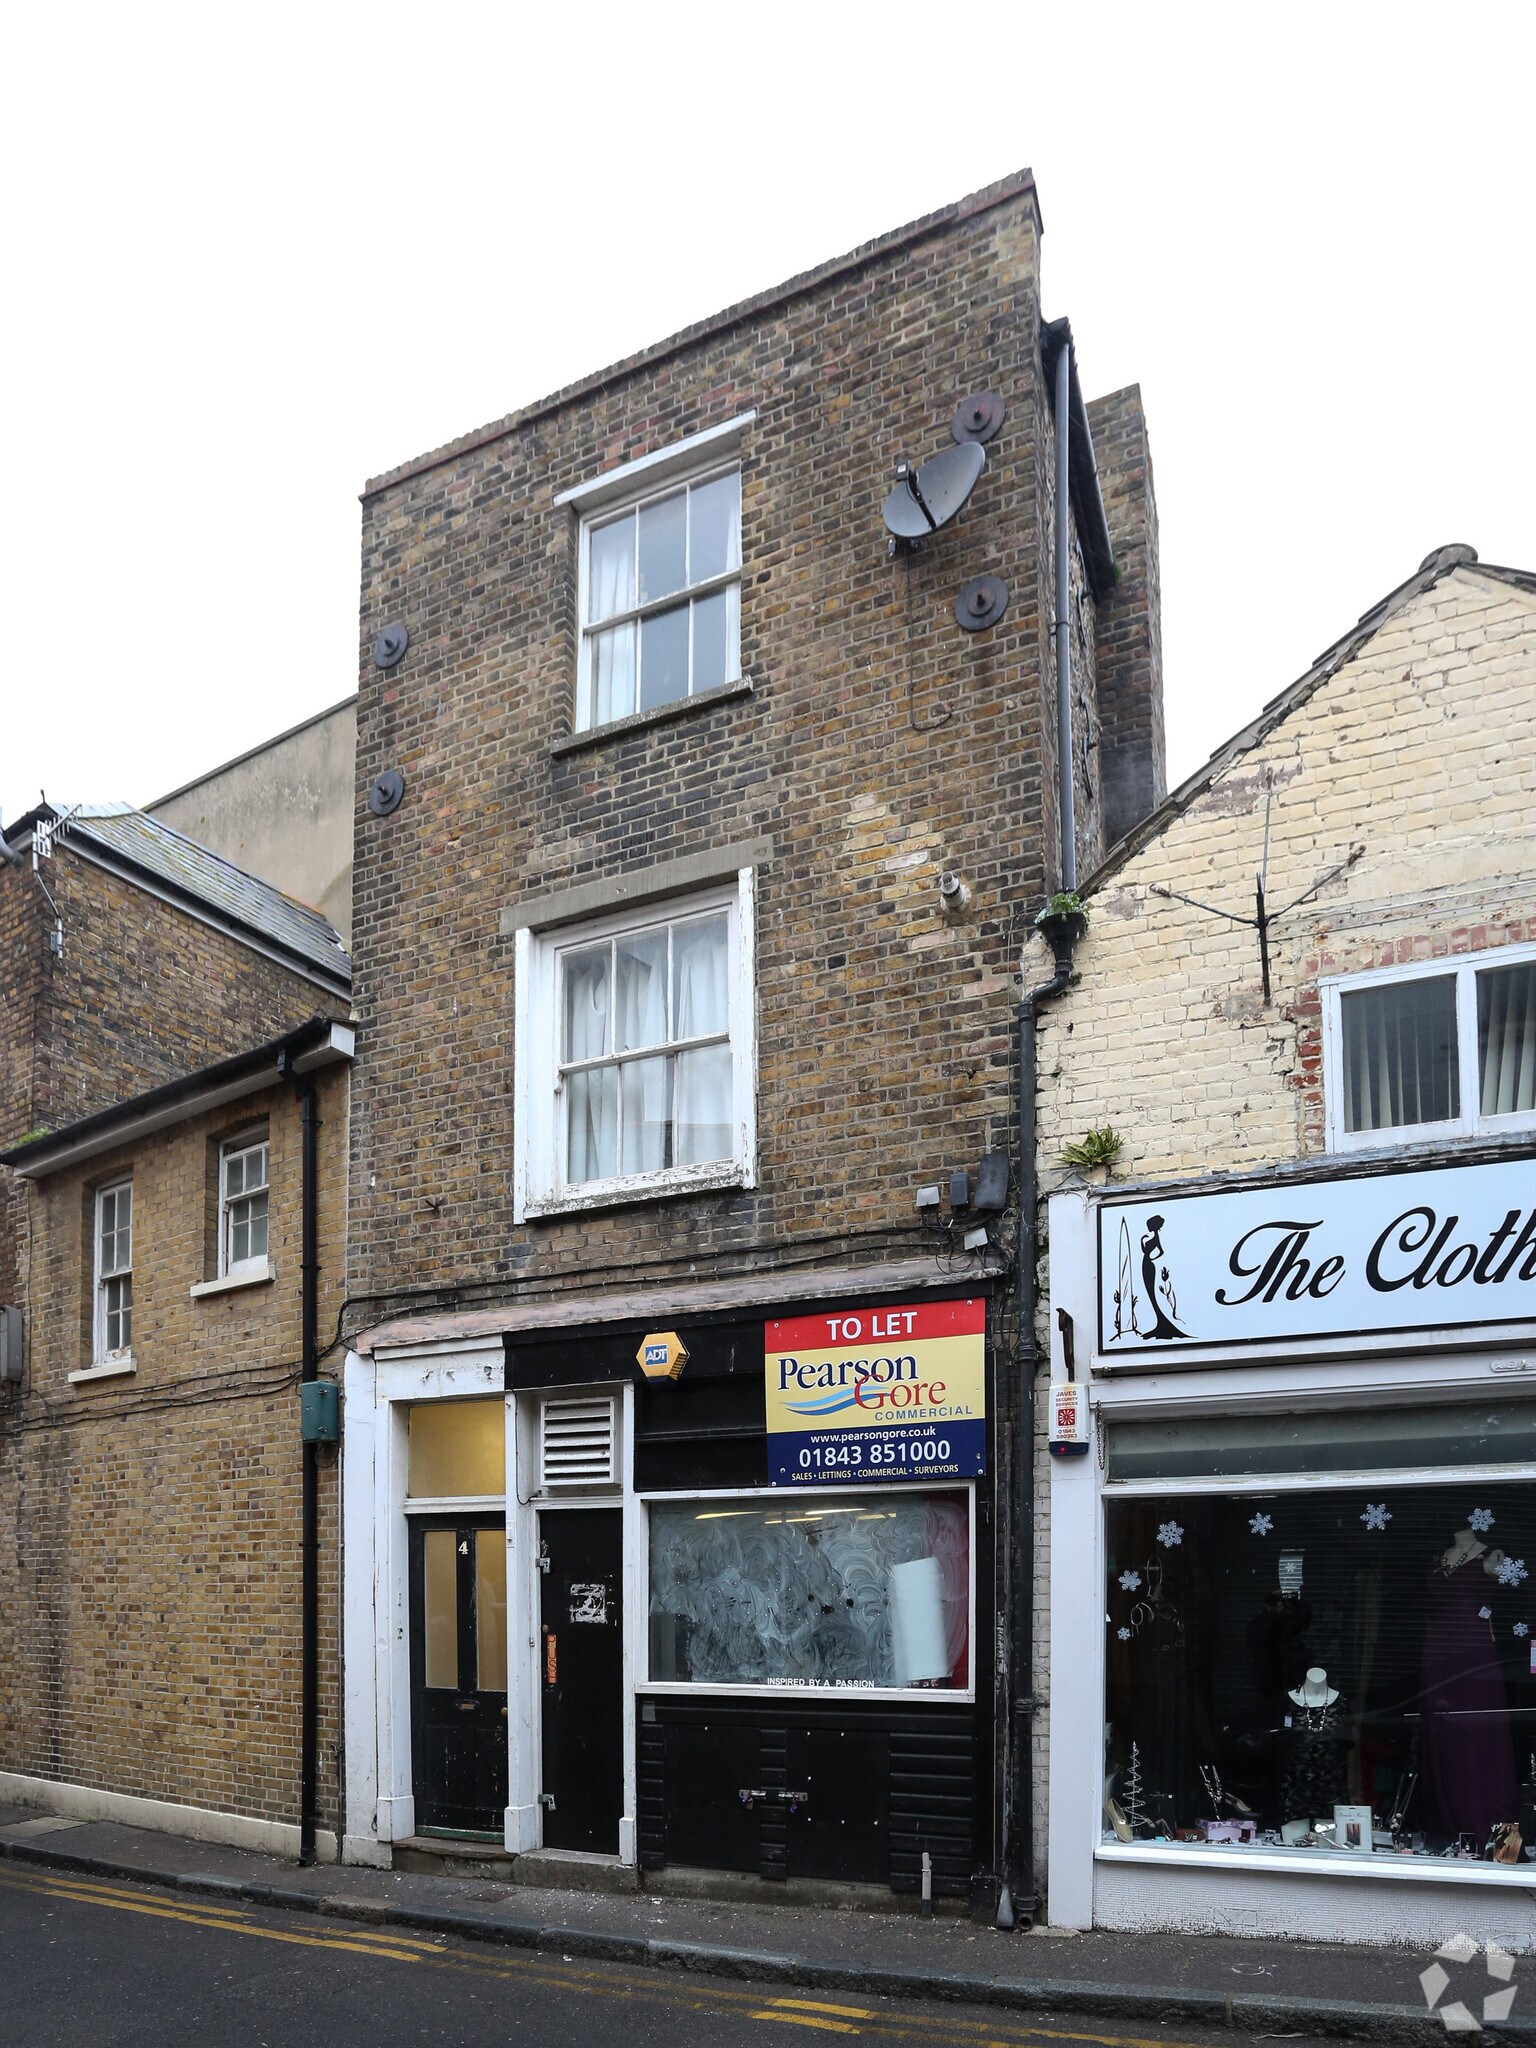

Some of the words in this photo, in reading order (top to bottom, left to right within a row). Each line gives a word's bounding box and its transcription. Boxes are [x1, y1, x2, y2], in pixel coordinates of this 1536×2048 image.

[1215, 1220, 1346, 1305] The
[1365, 1206, 1536, 1293] Cloth
[826, 1317, 862, 1341] TO
[872, 1311, 917, 1337] LET
[646, 1349, 668, 1361] ADT
[777, 1355, 919, 1390] Pearson
[854, 1374, 946, 1409] Gore
[874, 1406, 973, 1421] COMMERCIAL
[811, 1426, 936, 1443] www.pearsongore.co.uk
[799, 1445, 862, 1468] 01843
[869, 1440, 951, 1464] 851000
[792, 1473, 813, 1481] SALES
[818, 1470, 851, 1480] LETTINGS
[857, 1467, 908, 1478] COMMERCIAL
[914, 1464, 959, 1475] SURVEYORS
[458, 1541, 468, 1555] 4
[767, 1677, 805, 1686] INSPIRED
[809, 1679, 820, 1687] BY
[836, 1680, 874, 1688] PASSION
